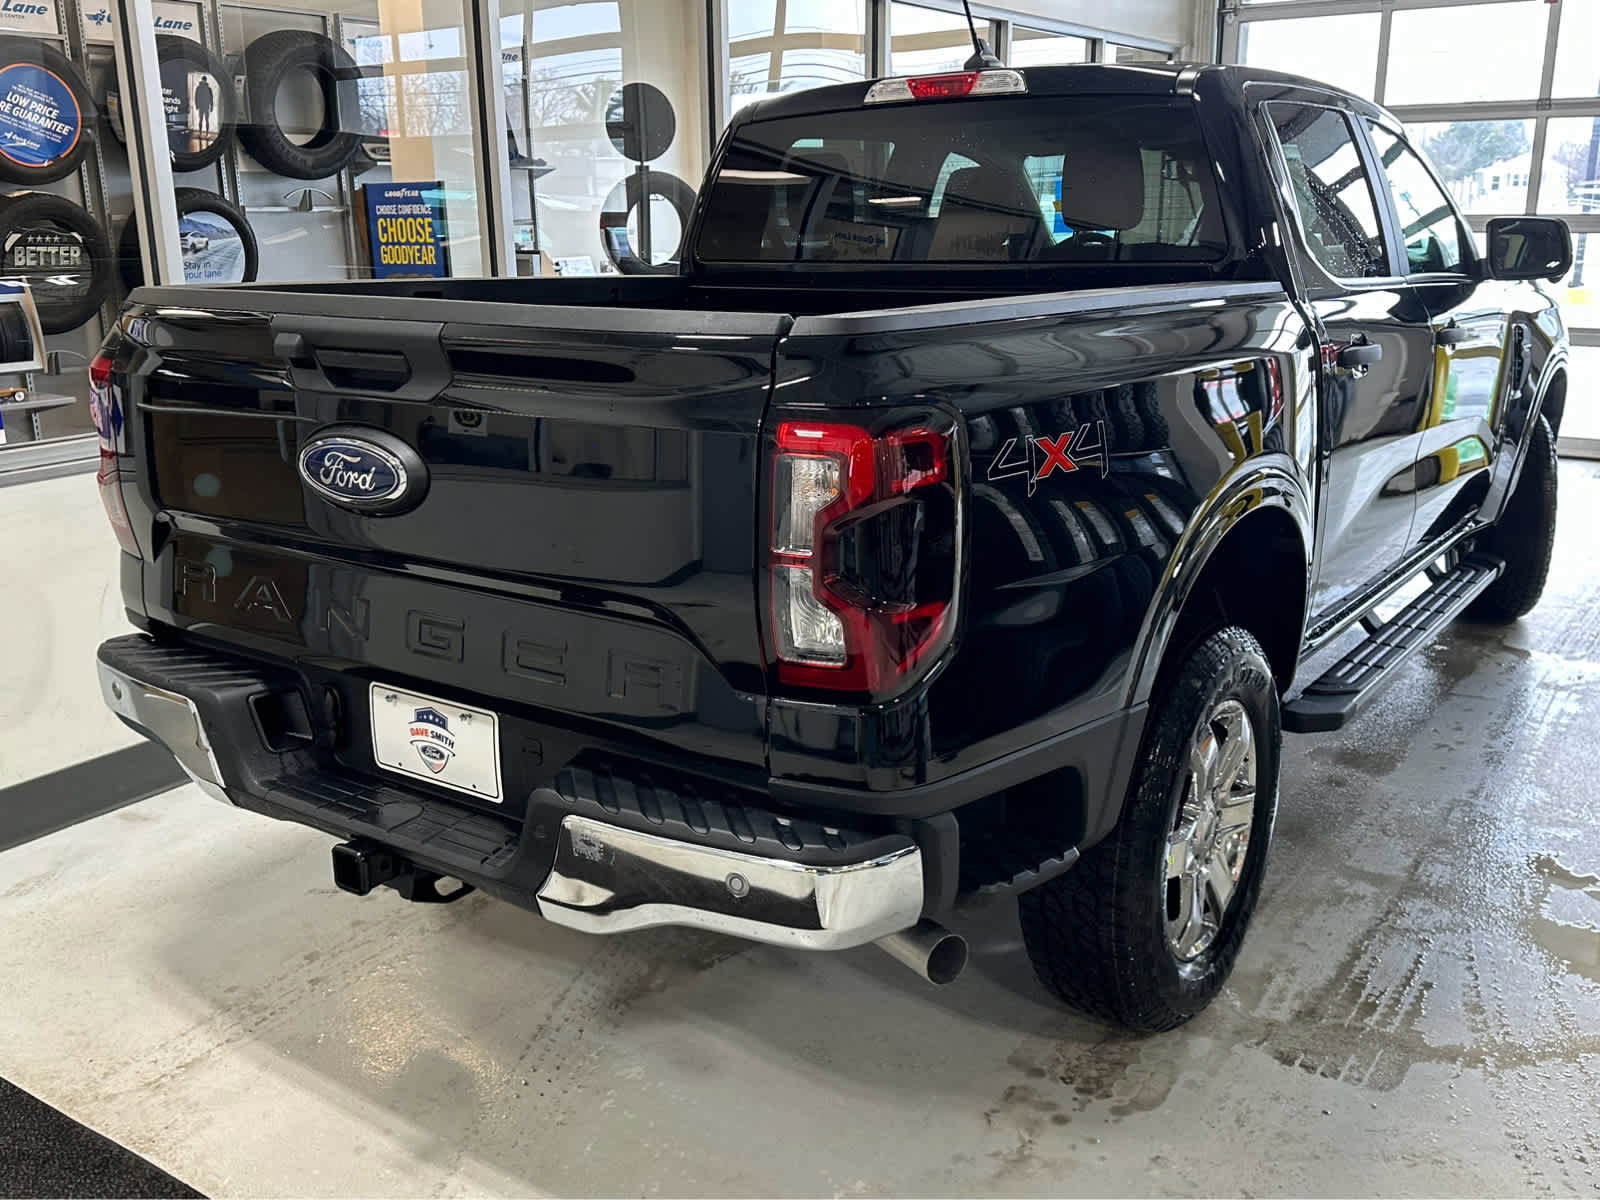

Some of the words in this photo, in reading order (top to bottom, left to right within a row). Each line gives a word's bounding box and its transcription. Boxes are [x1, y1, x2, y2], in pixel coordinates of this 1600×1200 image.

[2, 0, 48, 15] Lane
[154, 16, 192, 30] Lane
[6, 91, 31, 107] LOW
[29, 101, 60, 119] PRICE
[12, 106, 72, 136] GUARANTEE
[377, 218, 434, 243] CHOOSE
[14, 246, 81, 266] BETTER
[184, 261, 200, 271] Stay
[381, 246, 436, 265] GOODYEAR
[184, 271, 201, 281] your
[204, 270, 223, 279] lane
[320, 451, 376, 491] Ford
[174, 558, 682, 712] RANGER
[410, 727, 429, 737] DAVE
[430, 730, 454, 749] SMITH
